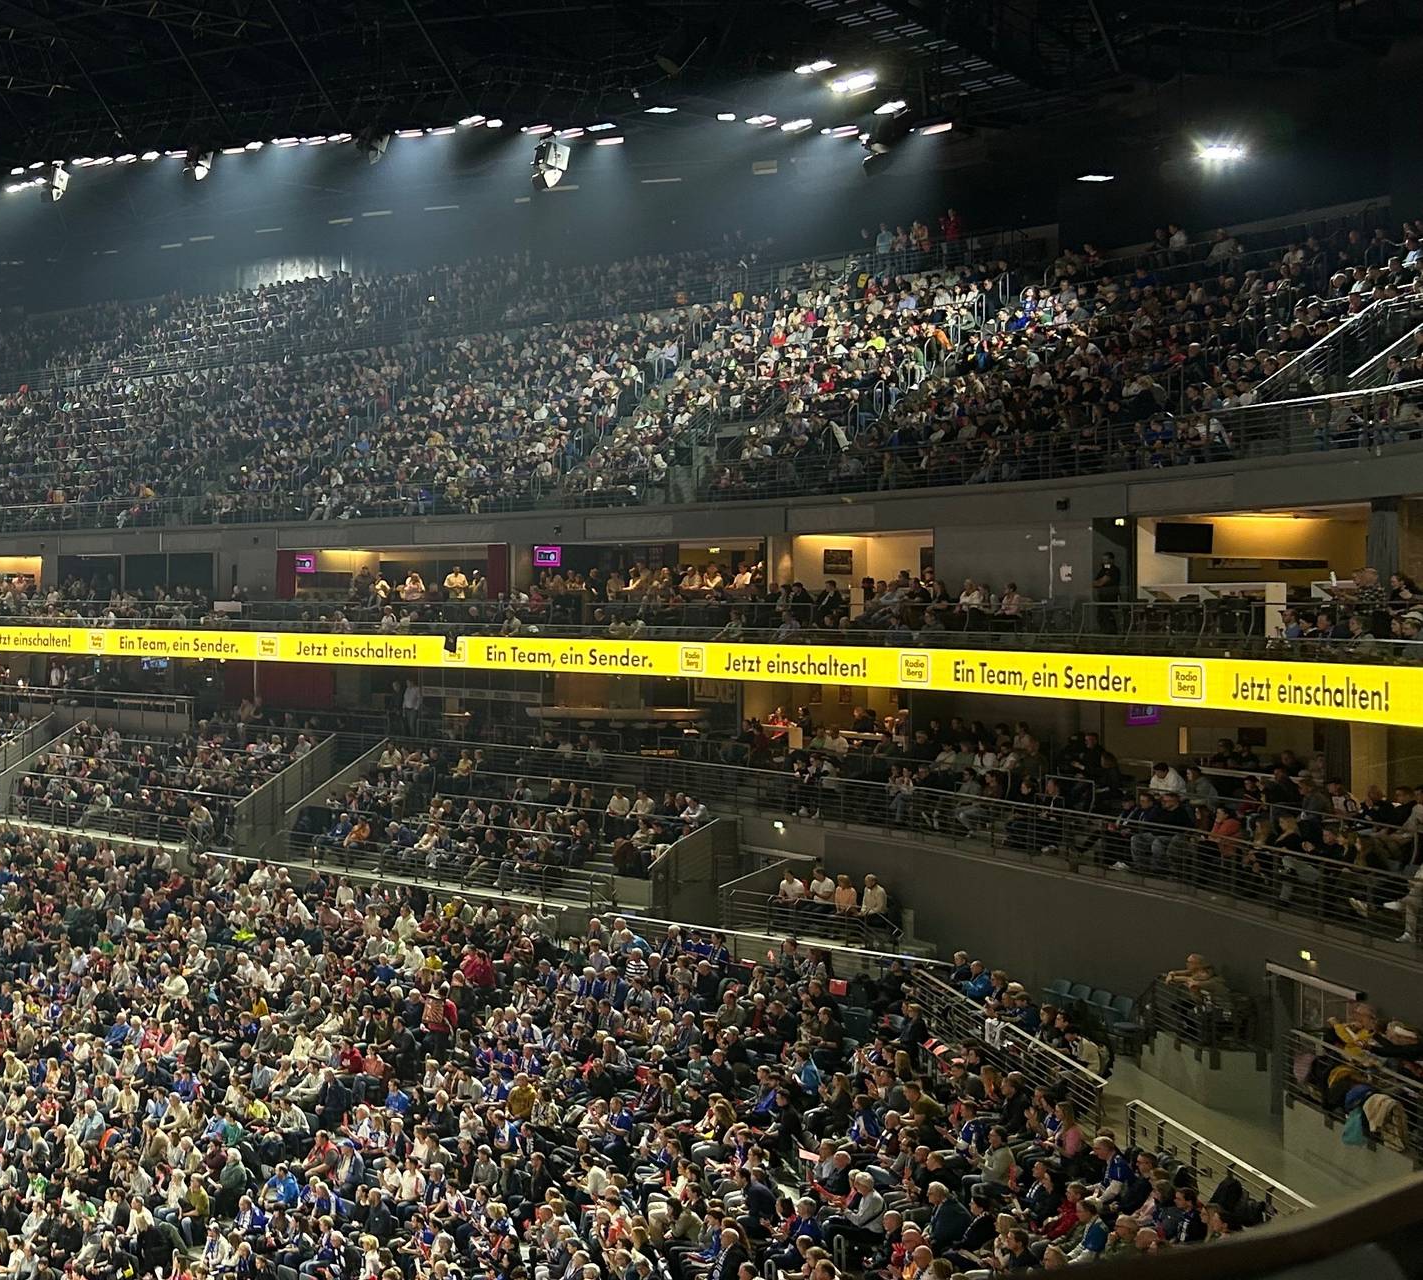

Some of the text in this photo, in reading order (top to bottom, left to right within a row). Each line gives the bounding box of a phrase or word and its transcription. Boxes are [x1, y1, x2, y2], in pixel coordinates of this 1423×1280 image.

[13, 632, 71, 648] einschalten!
[119, 635, 239, 654] Ein Team, ein Sender.
[296, 640, 417, 660] Jetzt einschalten!
[486, 644, 653, 668] Ein Team, ein Sender.
[724, 652, 867, 678] Jetzt einschalten!
[904, 658, 926, 669] Radio
[906, 667, 923, 679] Berg
[953, 659, 1137, 694] Ein Team, ein Sender.
[1174, 670, 1197, 682] Radio
[1177, 681, 1194, 695] Berg
[1231, 672, 1390, 713] Jetzt einschalten!
